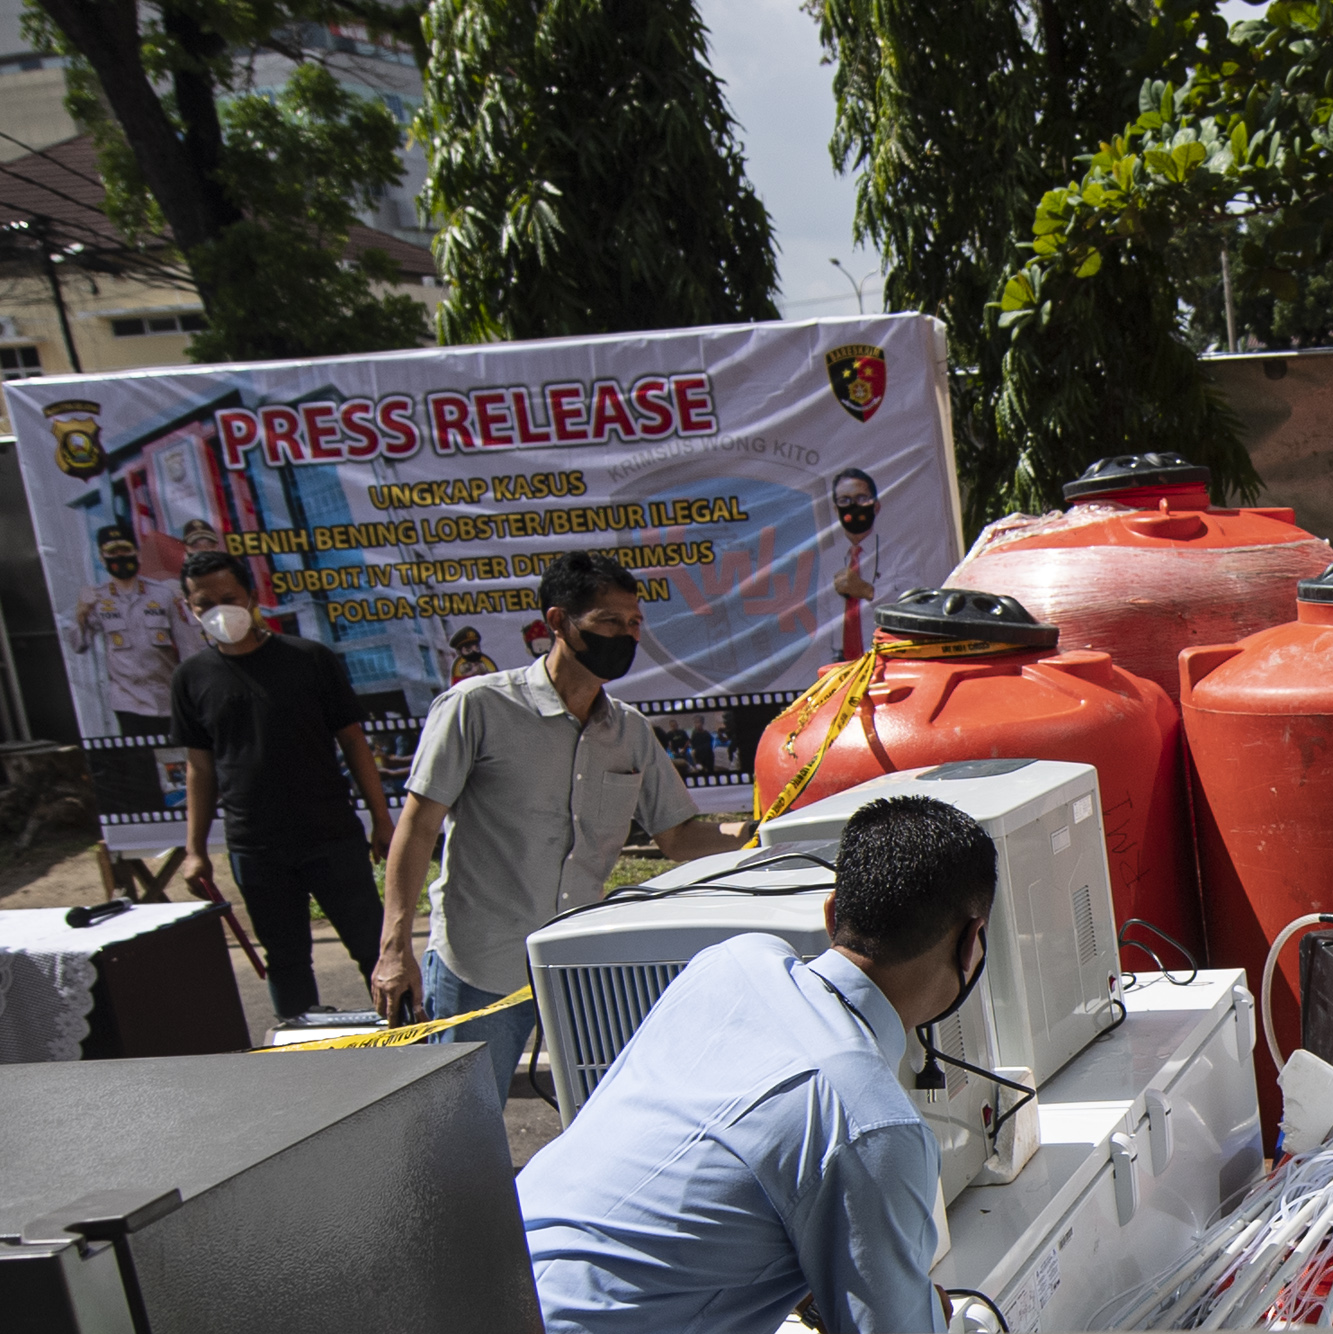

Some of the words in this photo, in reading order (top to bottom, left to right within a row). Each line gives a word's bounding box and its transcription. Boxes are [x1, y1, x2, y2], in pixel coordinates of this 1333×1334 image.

[217, 396, 420, 470] PRESS
[427, 373, 718, 455] RELEASE
[606, 438, 695, 484] KRIMSUS
[702, 434, 767, 454] WONG
[774, 440, 821, 467] KITO
[369, 477, 488, 511] UNGKAP
[493, 471, 587, 501] KASUS
[226, 528, 309, 557] BENIH
[315, 519, 418, 552] BENING
[423, 502, 645, 547] LOBSTER/BENUR
[650, 497, 748, 527] ILEGAL
[271, 567, 362, 595] SUBDIT
[367, 562, 393, 588] IV
[396, 555, 508, 587] TIPIDTER
[511, 541, 715, 579] DITKRIMSUS
[328, 598, 414, 625] POLDA
[418, 591, 541, 620] SUMATER
